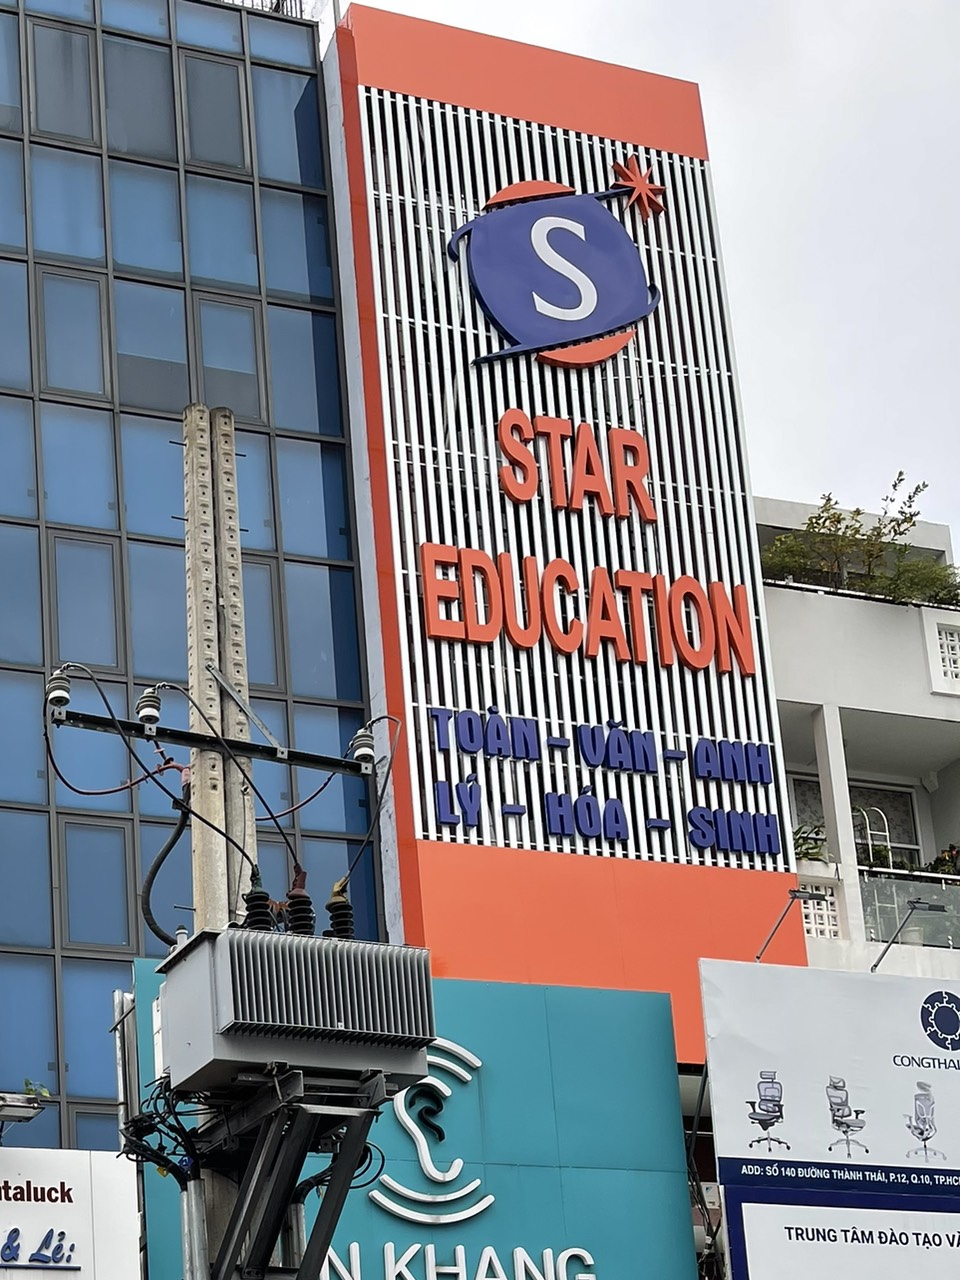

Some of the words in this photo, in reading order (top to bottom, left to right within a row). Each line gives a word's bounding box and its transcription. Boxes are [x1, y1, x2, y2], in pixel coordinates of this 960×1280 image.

[531, 216, 598, 321] S
[498, 408, 657, 524] STAR
[420, 542, 755, 677] EDUCATION
[578, 719, 658, 773] VĂN
[693, 738, 772, 785] ANH
[434, 773, 481, 828] LÝ
[545, 785, 629, 841] HÓA
[688, 806, 780, 855] SINH
[741, 1165, 764, 1175] ADD:
[765, 1163, 779, 1176] SỐ
[781, 1167, 796, 1177] 140
[797, 1166, 830, 1179] ĐƯỜNG
[832, 1168, 863, 1181] THÀNH
[864, 1170, 888, 1183] THÁI,
[889, 1173, 909, 1184] P.12,
[910, 1174, 932, 1186] Q.10,
[933, 1175, 960, 1186] TP.HC
[0, 1227, 21, 1262] &
[784, 1226, 837, 1243] TRUNG
[841, 1226, 874, 1244] TÂM
[878, 1228, 909, 1246] ĐÀO
[912, 1232, 942, 1249] TẠO
